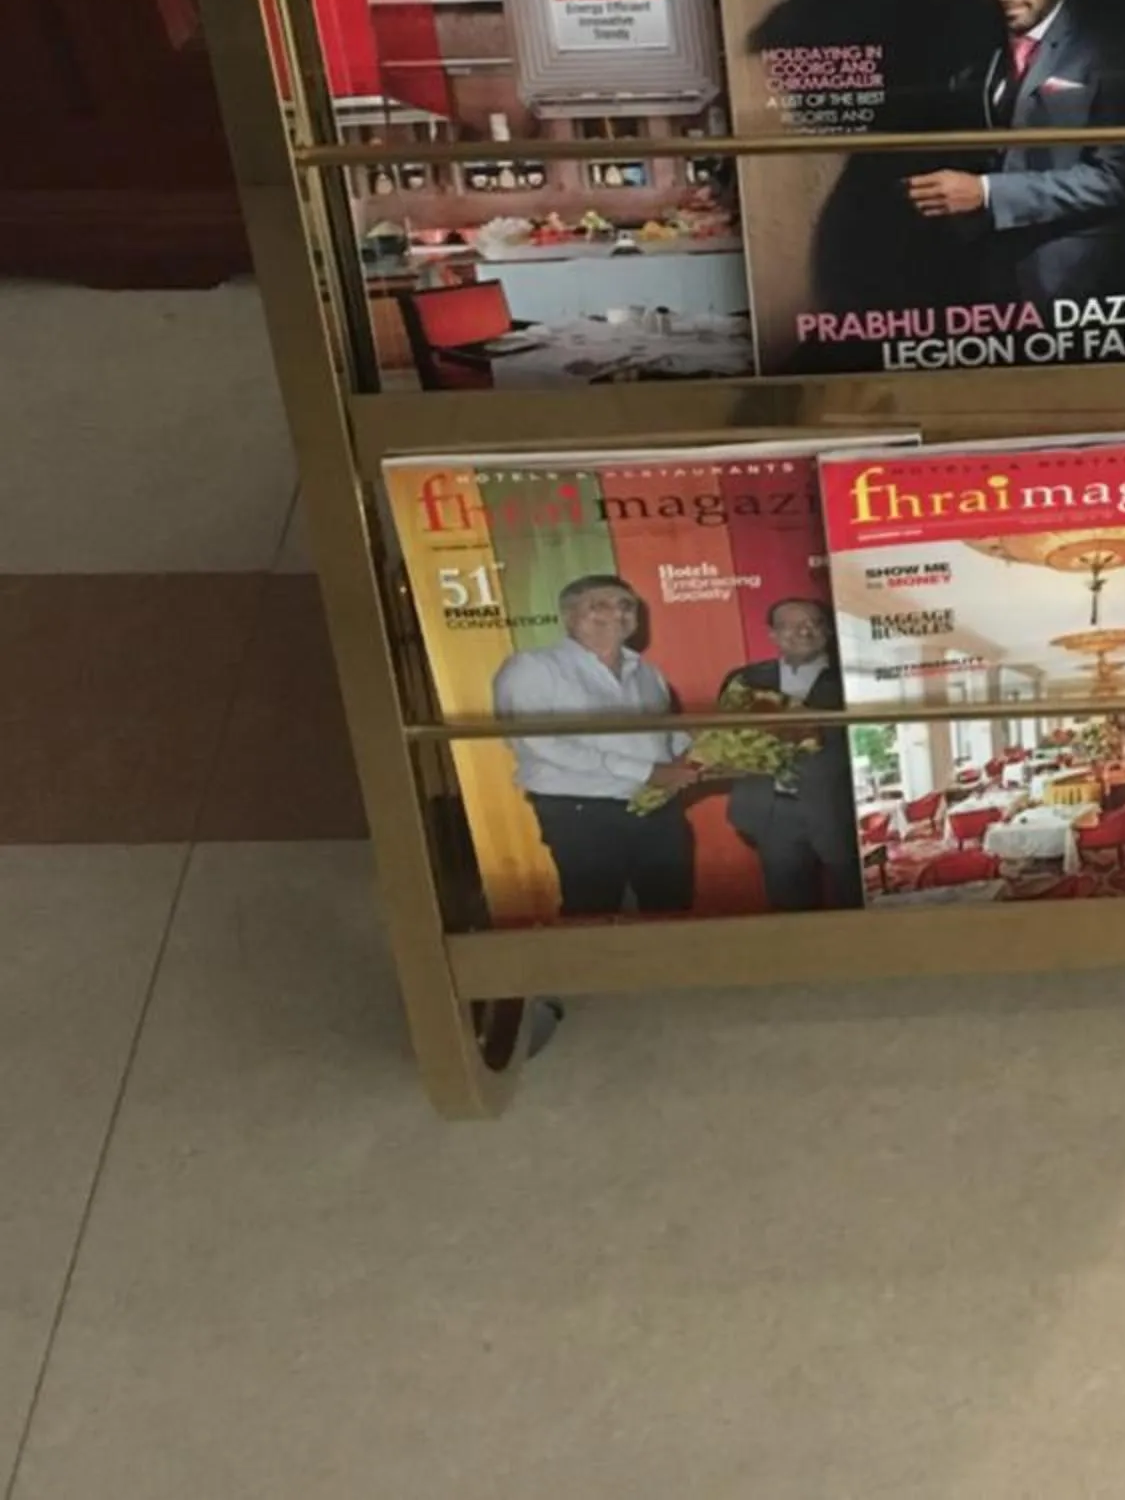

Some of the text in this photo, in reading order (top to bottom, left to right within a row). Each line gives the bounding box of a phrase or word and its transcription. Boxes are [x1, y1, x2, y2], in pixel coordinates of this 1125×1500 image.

[795, 307, 934, 342] PRABHU
[946, 301, 1043, 337] DEVA
[882, 336, 1015, 371] LEGION
[1024, 331, 1075, 364] OF
